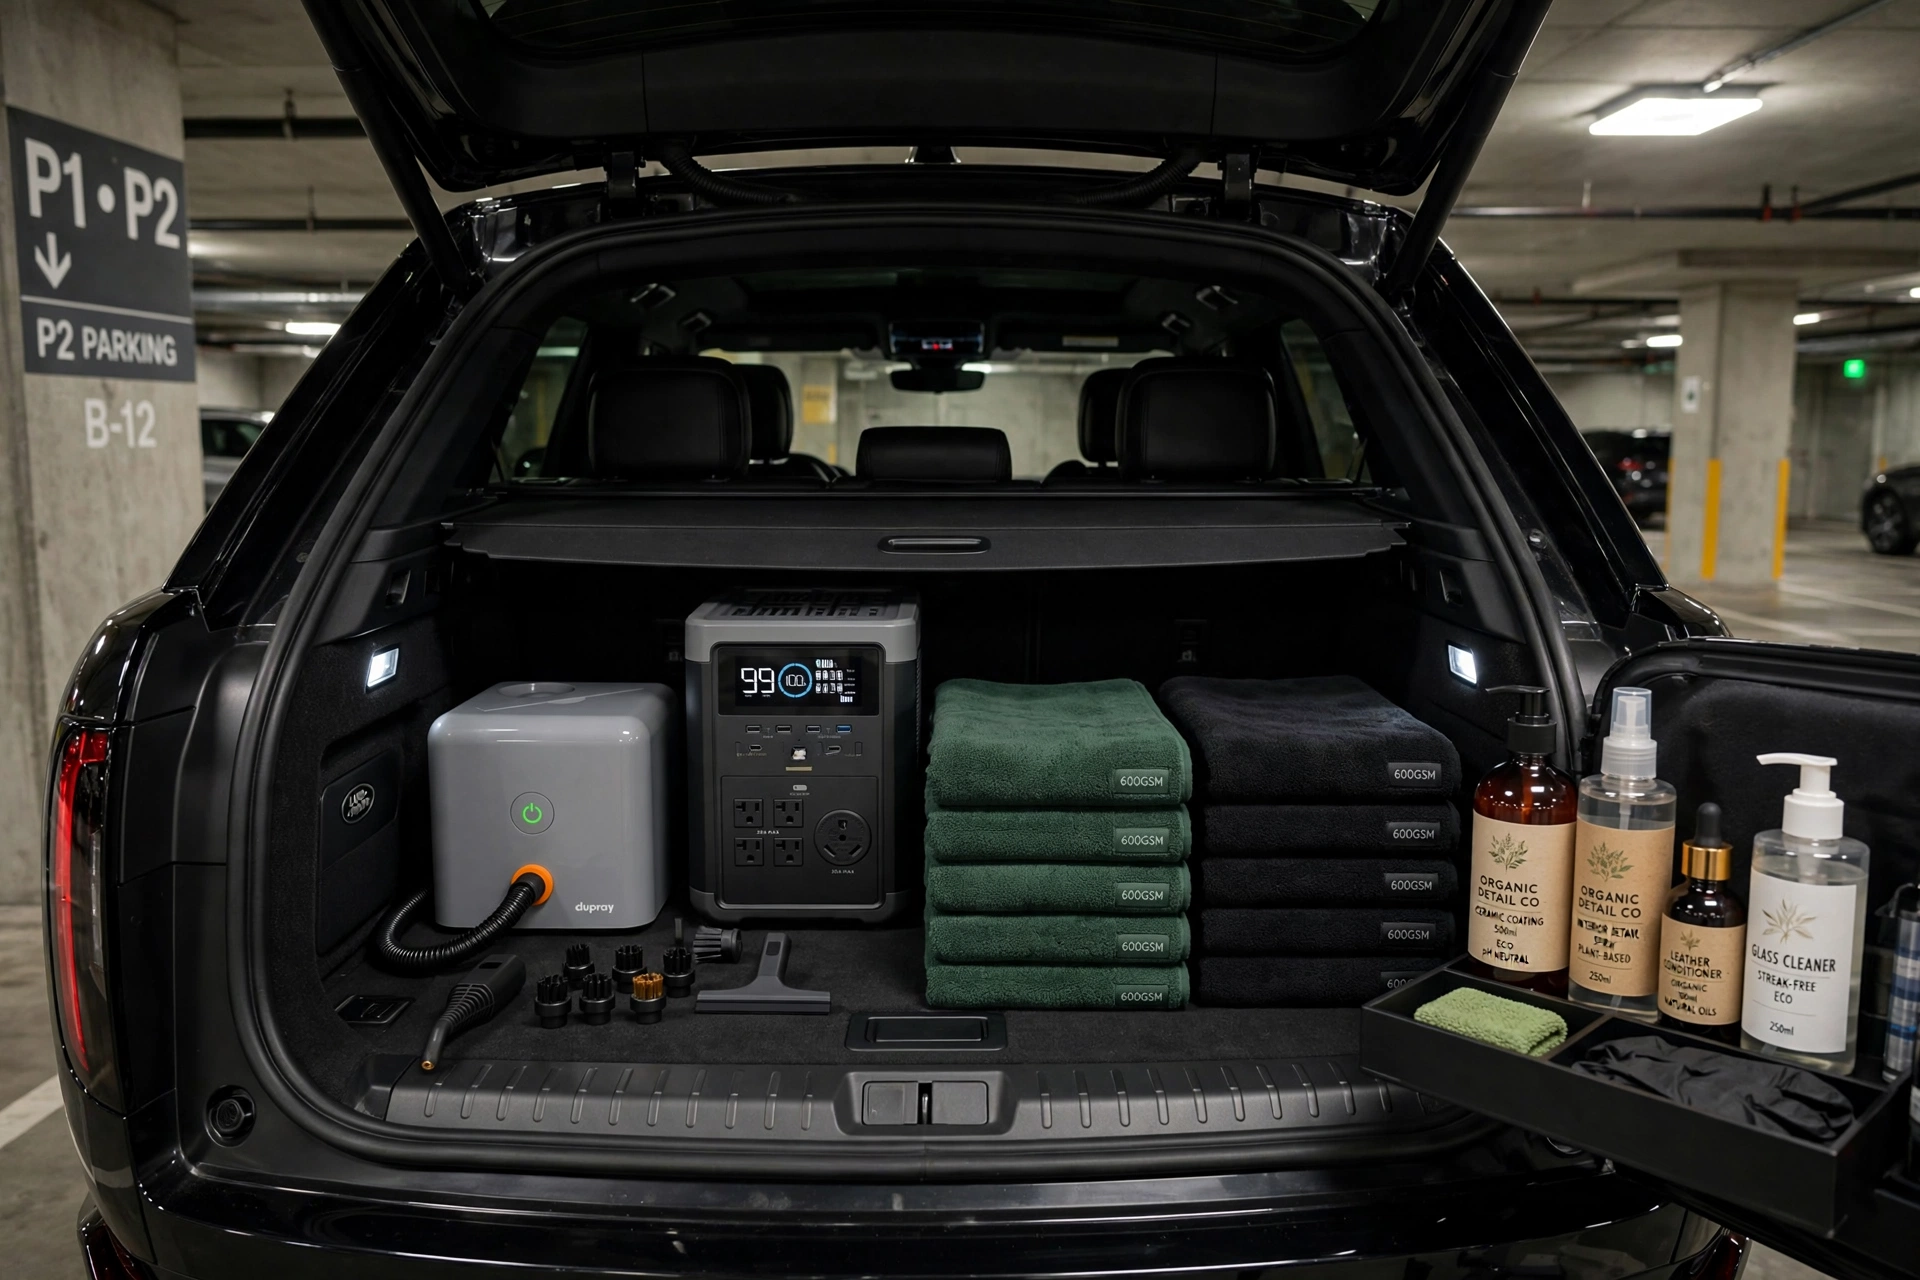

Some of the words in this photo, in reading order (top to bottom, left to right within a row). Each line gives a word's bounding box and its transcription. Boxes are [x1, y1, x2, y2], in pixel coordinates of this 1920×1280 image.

[25, 137, 86, 228] P1
[124, 166, 181, 249] P2
[37, 317, 75, 361] P2
[82, 325, 178, 366] PARKING
[85, 398, 157, 449] B-12
[1120, 775, 1163, 787] 600GSM
[1394, 769, 1436, 780] 600GSM
[1121, 834, 1164, 846] 600GSM
[1393, 828, 1435, 839] 600GSM
[1390, 880, 1433, 891] 600GSM
[1480, 874, 1538, 894] ORGANIC
[1121, 889, 1164, 901] 600GSM
[1478, 886, 1516, 906] DETAIL
[1520, 896, 1540, 908] CO
[1581, 885, 1640, 905] ORGANIC
[575, 901, 615, 914] dupray
[1579, 896, 1617, 917] DETAIL
[1621, 907, 1642, 919] CO
[1507, 914, 1544, 926] COATING
[1387, 929, 1430, 940] 600GSM
[1121, 941, 1164, 953] 600GSM
[1496, 938, 1514, 951] ECO
[1494, 950, 1529, 965] NEUTRAL
[1578, 943, 1632, 964] PLANT-BASED
[1670, 949, 1711, 968] LEATHER
[1751, 943, 1779, 965] GLASS
[1783, 954, 1836, 973] CLEANER
[1589, 970, 1612, 984] 250ml
[1757, 970, 1817, 993] STREAK-FREE
[1120, 991, 1163, 1002] 600GSM
[1774, 990, 1793, 1005] ECO
[1698, 1006, 1717, 1016] OILS
[1769, 1020, 1795, 1036] 250ml
